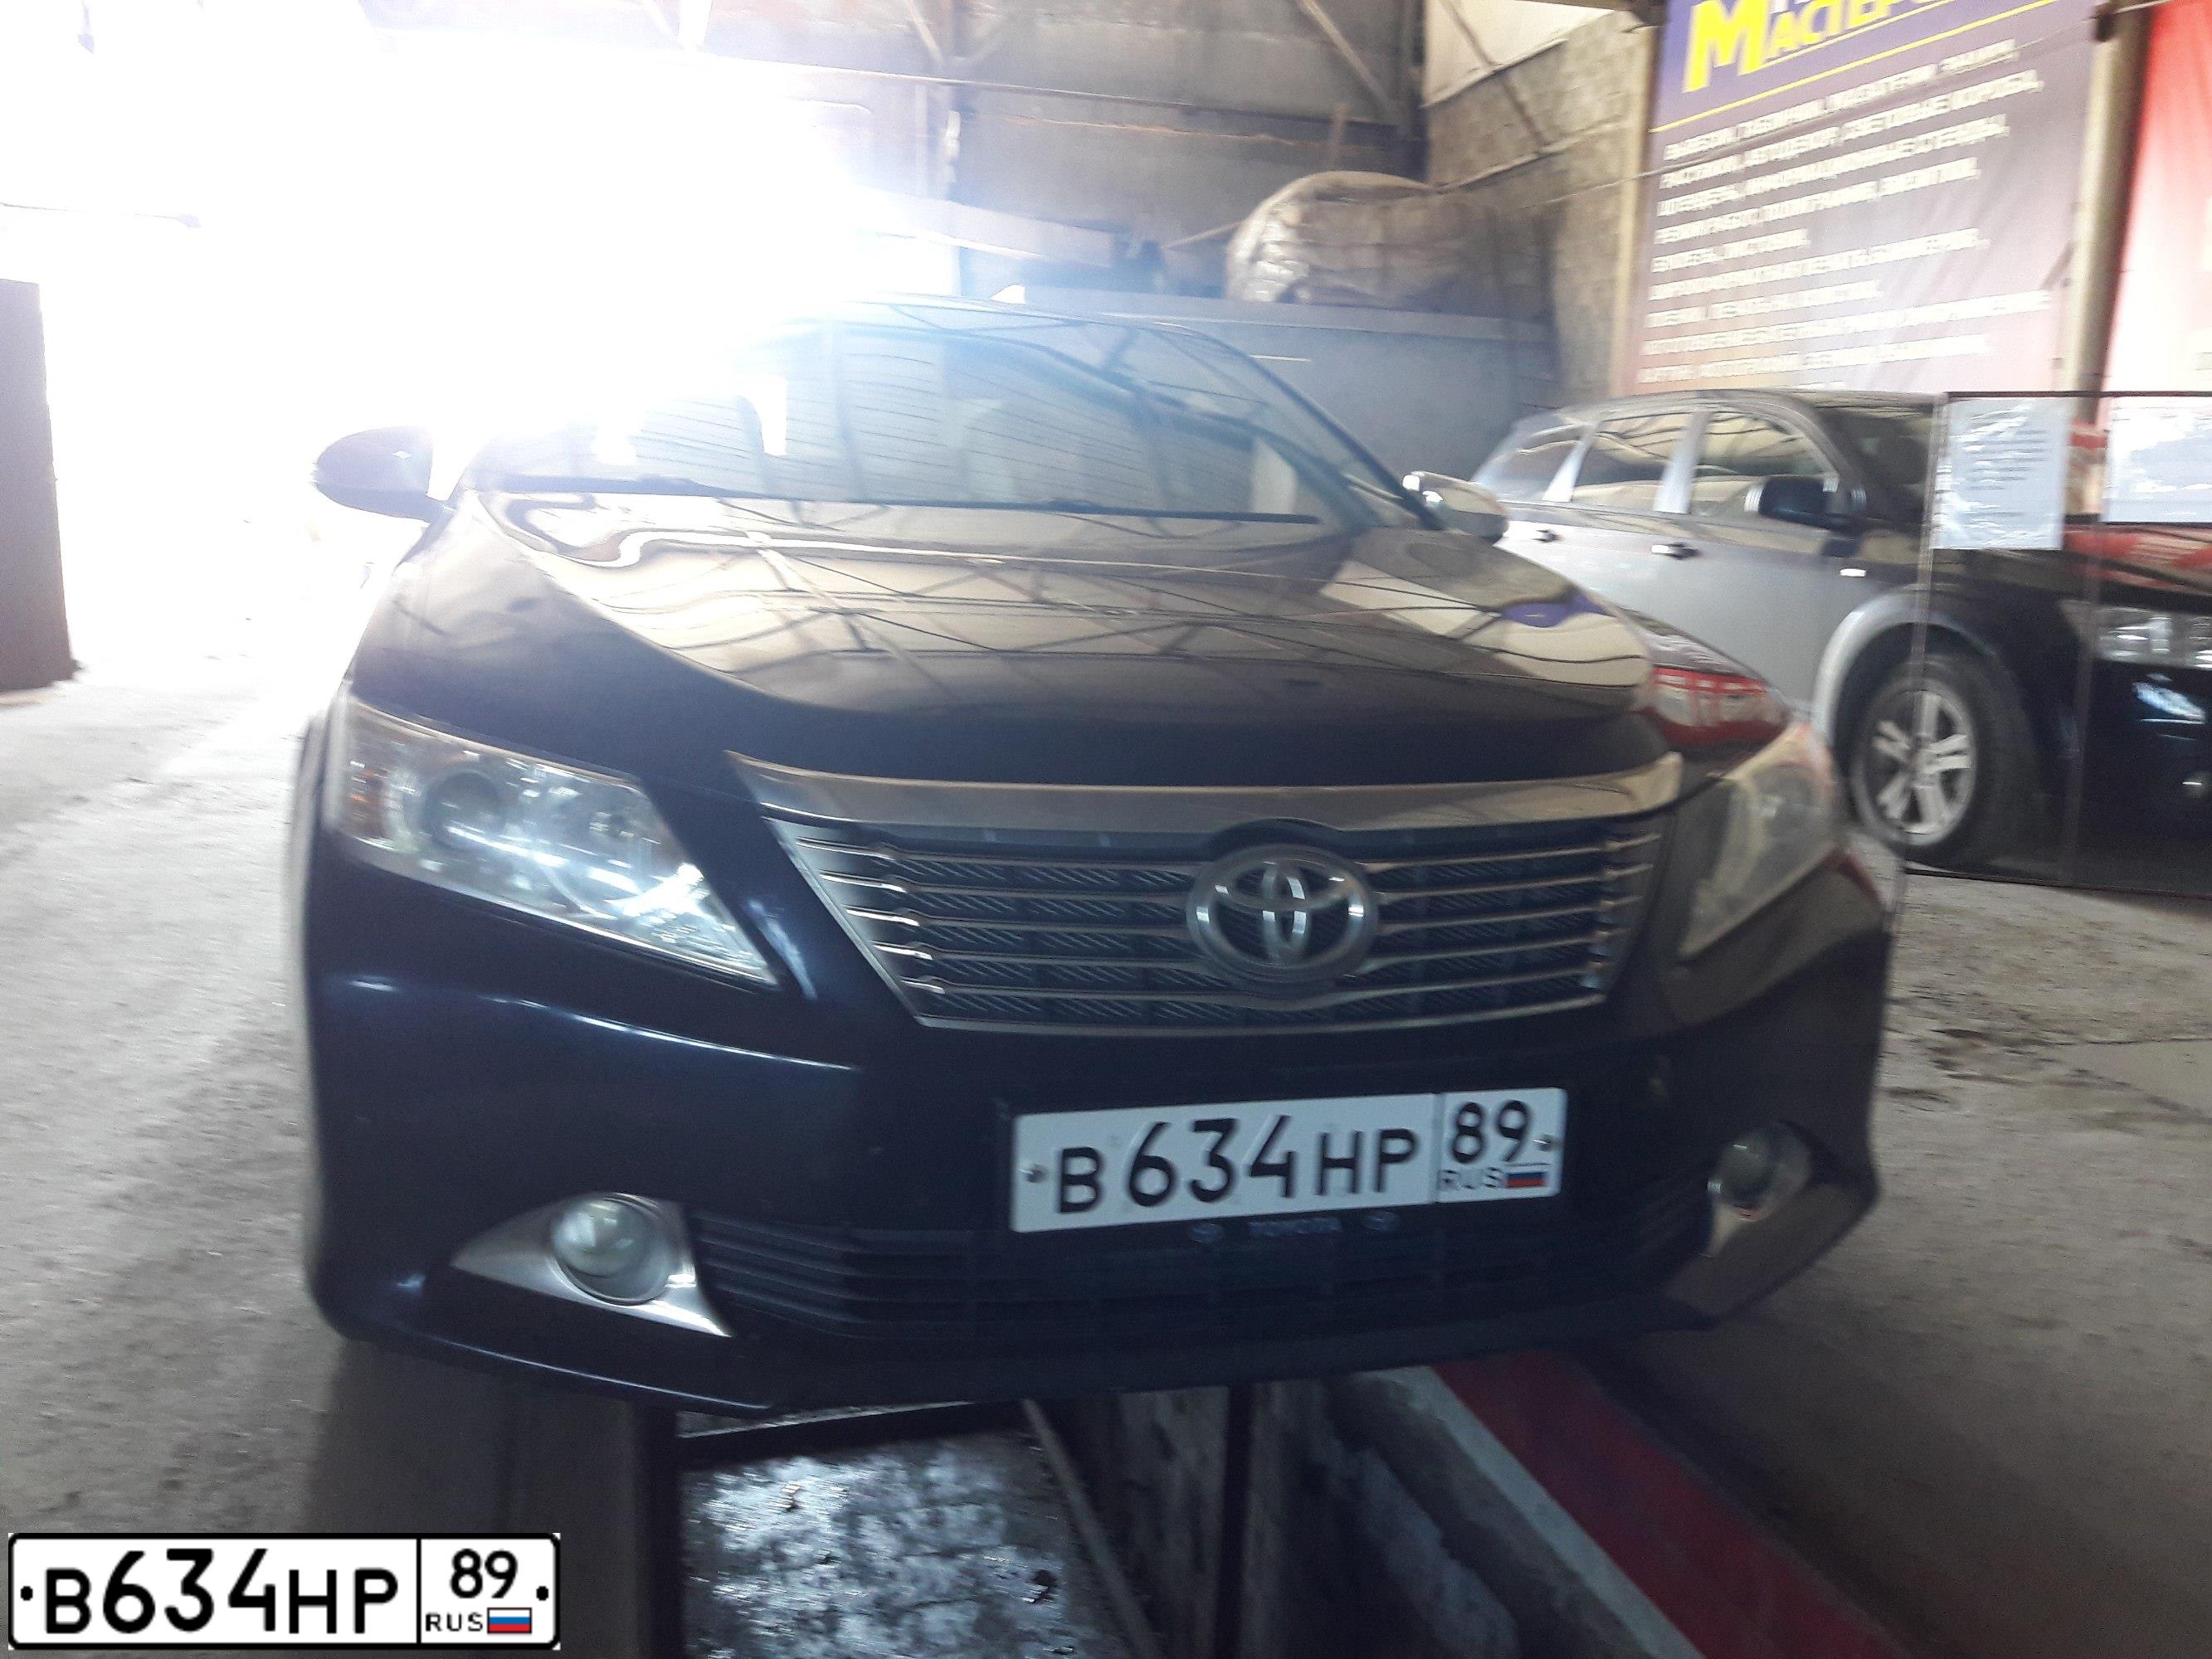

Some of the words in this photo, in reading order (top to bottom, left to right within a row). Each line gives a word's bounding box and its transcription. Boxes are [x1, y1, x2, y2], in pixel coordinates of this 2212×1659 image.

[1055, 1114, 1419, 1214] В634НР
[1450, 1099, 1532, 1164] 89
[1440, 1166, 1504, 1191] RUS
